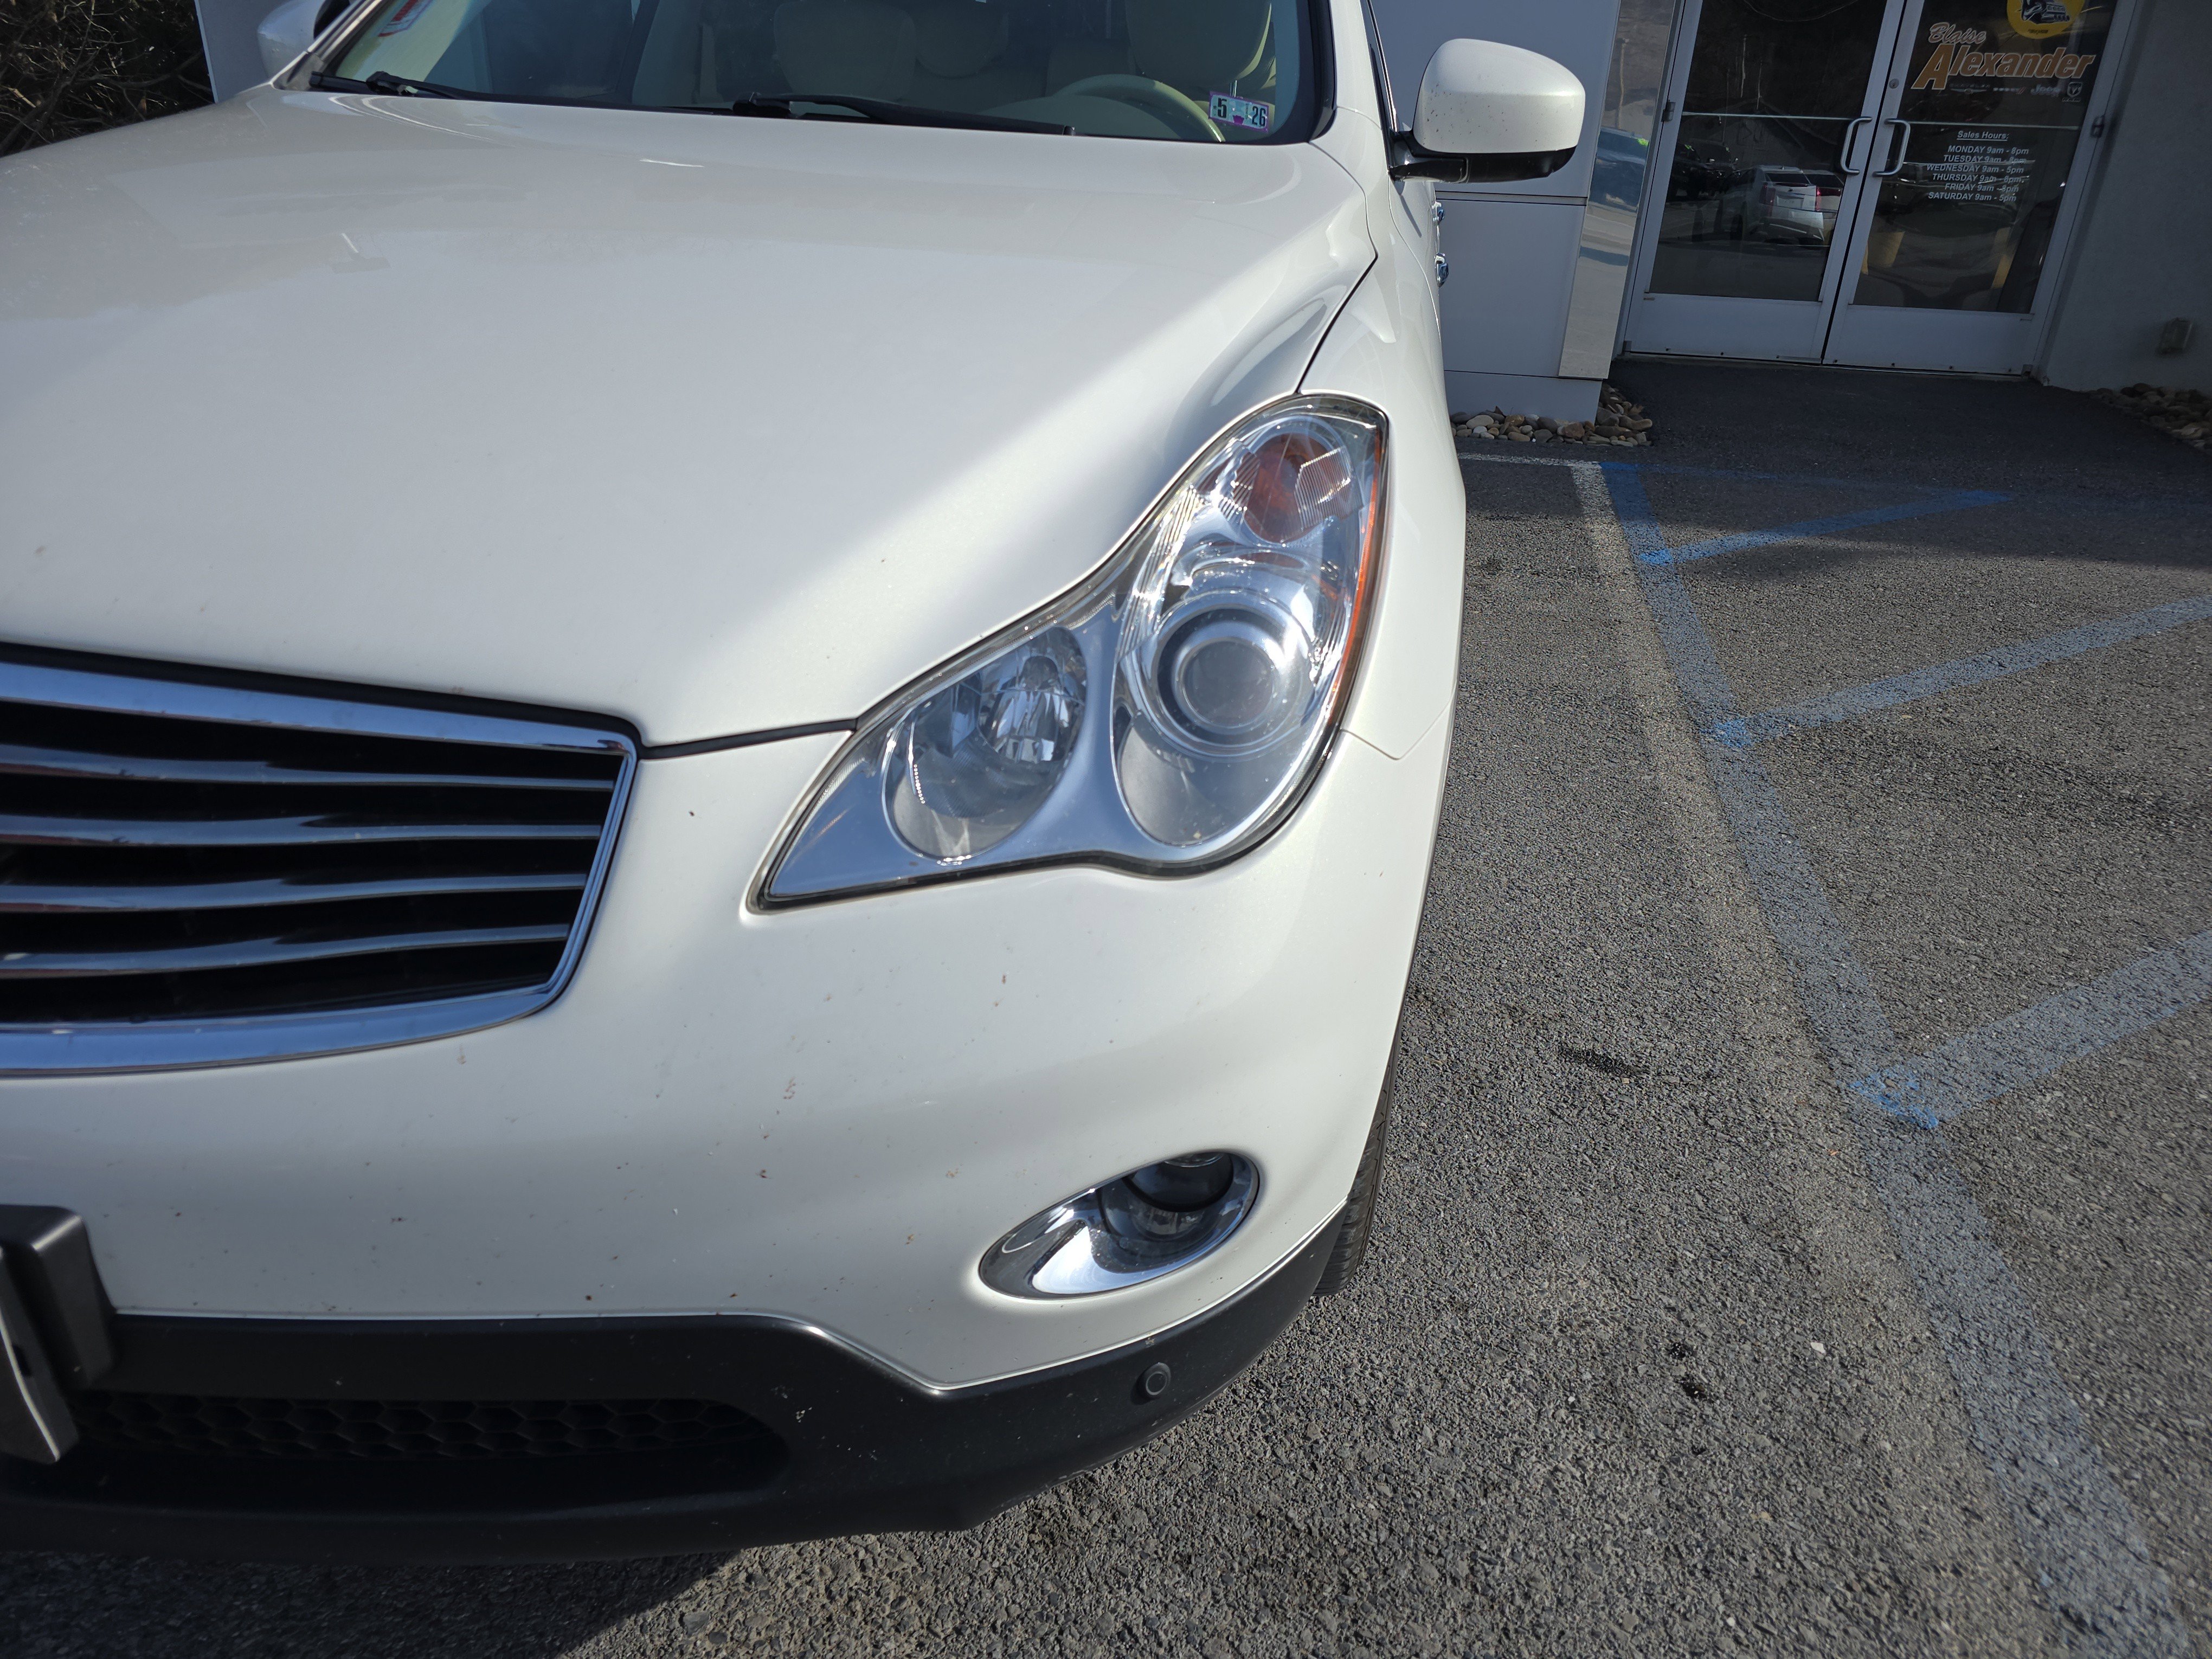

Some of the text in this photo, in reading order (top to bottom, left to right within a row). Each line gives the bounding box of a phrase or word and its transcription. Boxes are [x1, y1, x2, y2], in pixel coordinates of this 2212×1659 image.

[1928, 22, 1986, 44] Blaise
[1911, 43, 2096, 90] Alexander
[1218, 98, 1227, 118] 5
[1252, 106, 1266, 126] 26
[1957, 130, 1979, 139] Sales
[1947, 145, 1985, 153] MONDAY
[2011, 147, 2029, 156] 8pm
[1943, 155, 1984, 163] TUESDAY
[1927, 163, 1980, 172] WEDNESDAY
[2006, 166, 2024, 175] 5pm
[1932, 173, 1978, 182] THURSDAY
[1945, 183, 1976, 191] FRIDAY
[1928, 192, 1973, 200] SATURDAY
[1999, 194, 2017, 203] 5pm
